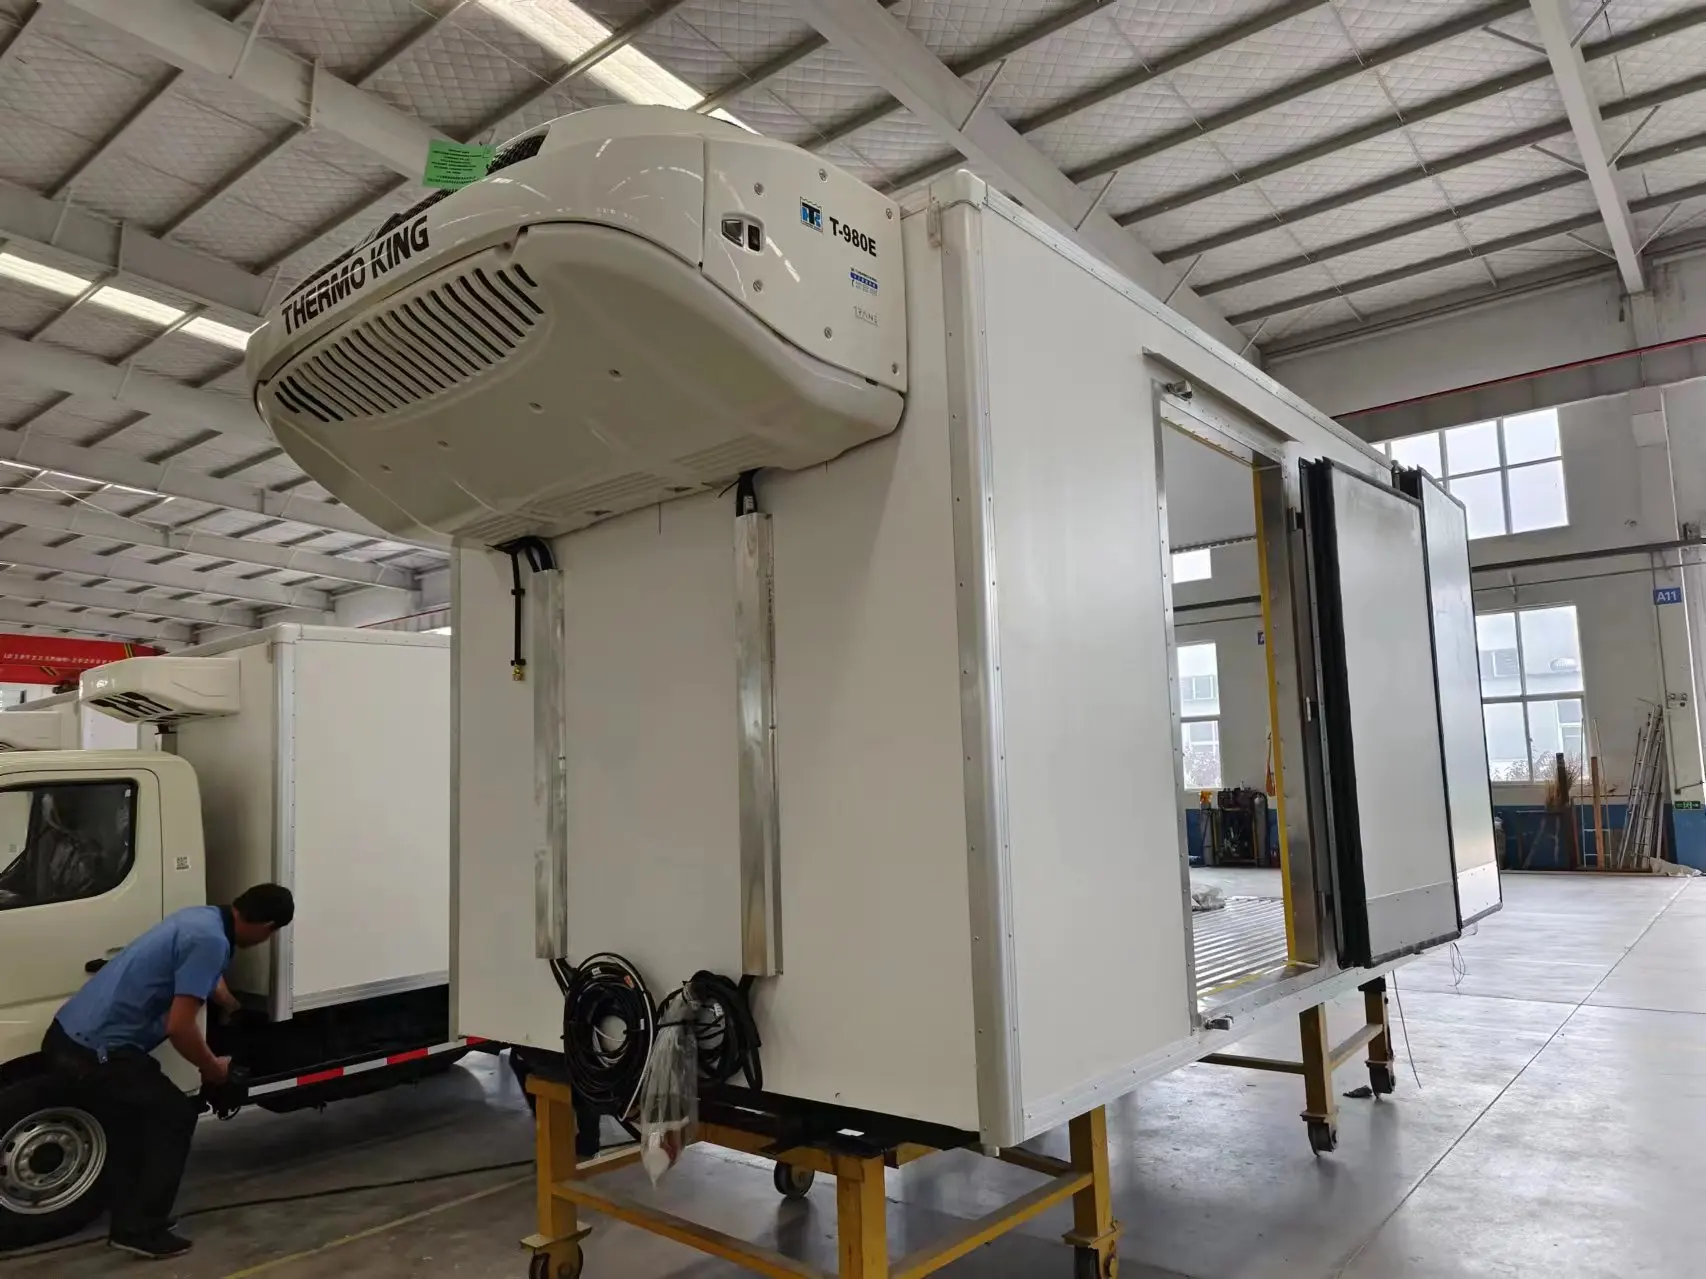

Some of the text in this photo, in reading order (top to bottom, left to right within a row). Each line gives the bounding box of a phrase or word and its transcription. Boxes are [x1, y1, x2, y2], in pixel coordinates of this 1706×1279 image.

[829, 216, 876, 257] T-980E
[280, 215, 430, 335] THERMO KING
[1657, 590, 1677, 602] A11
